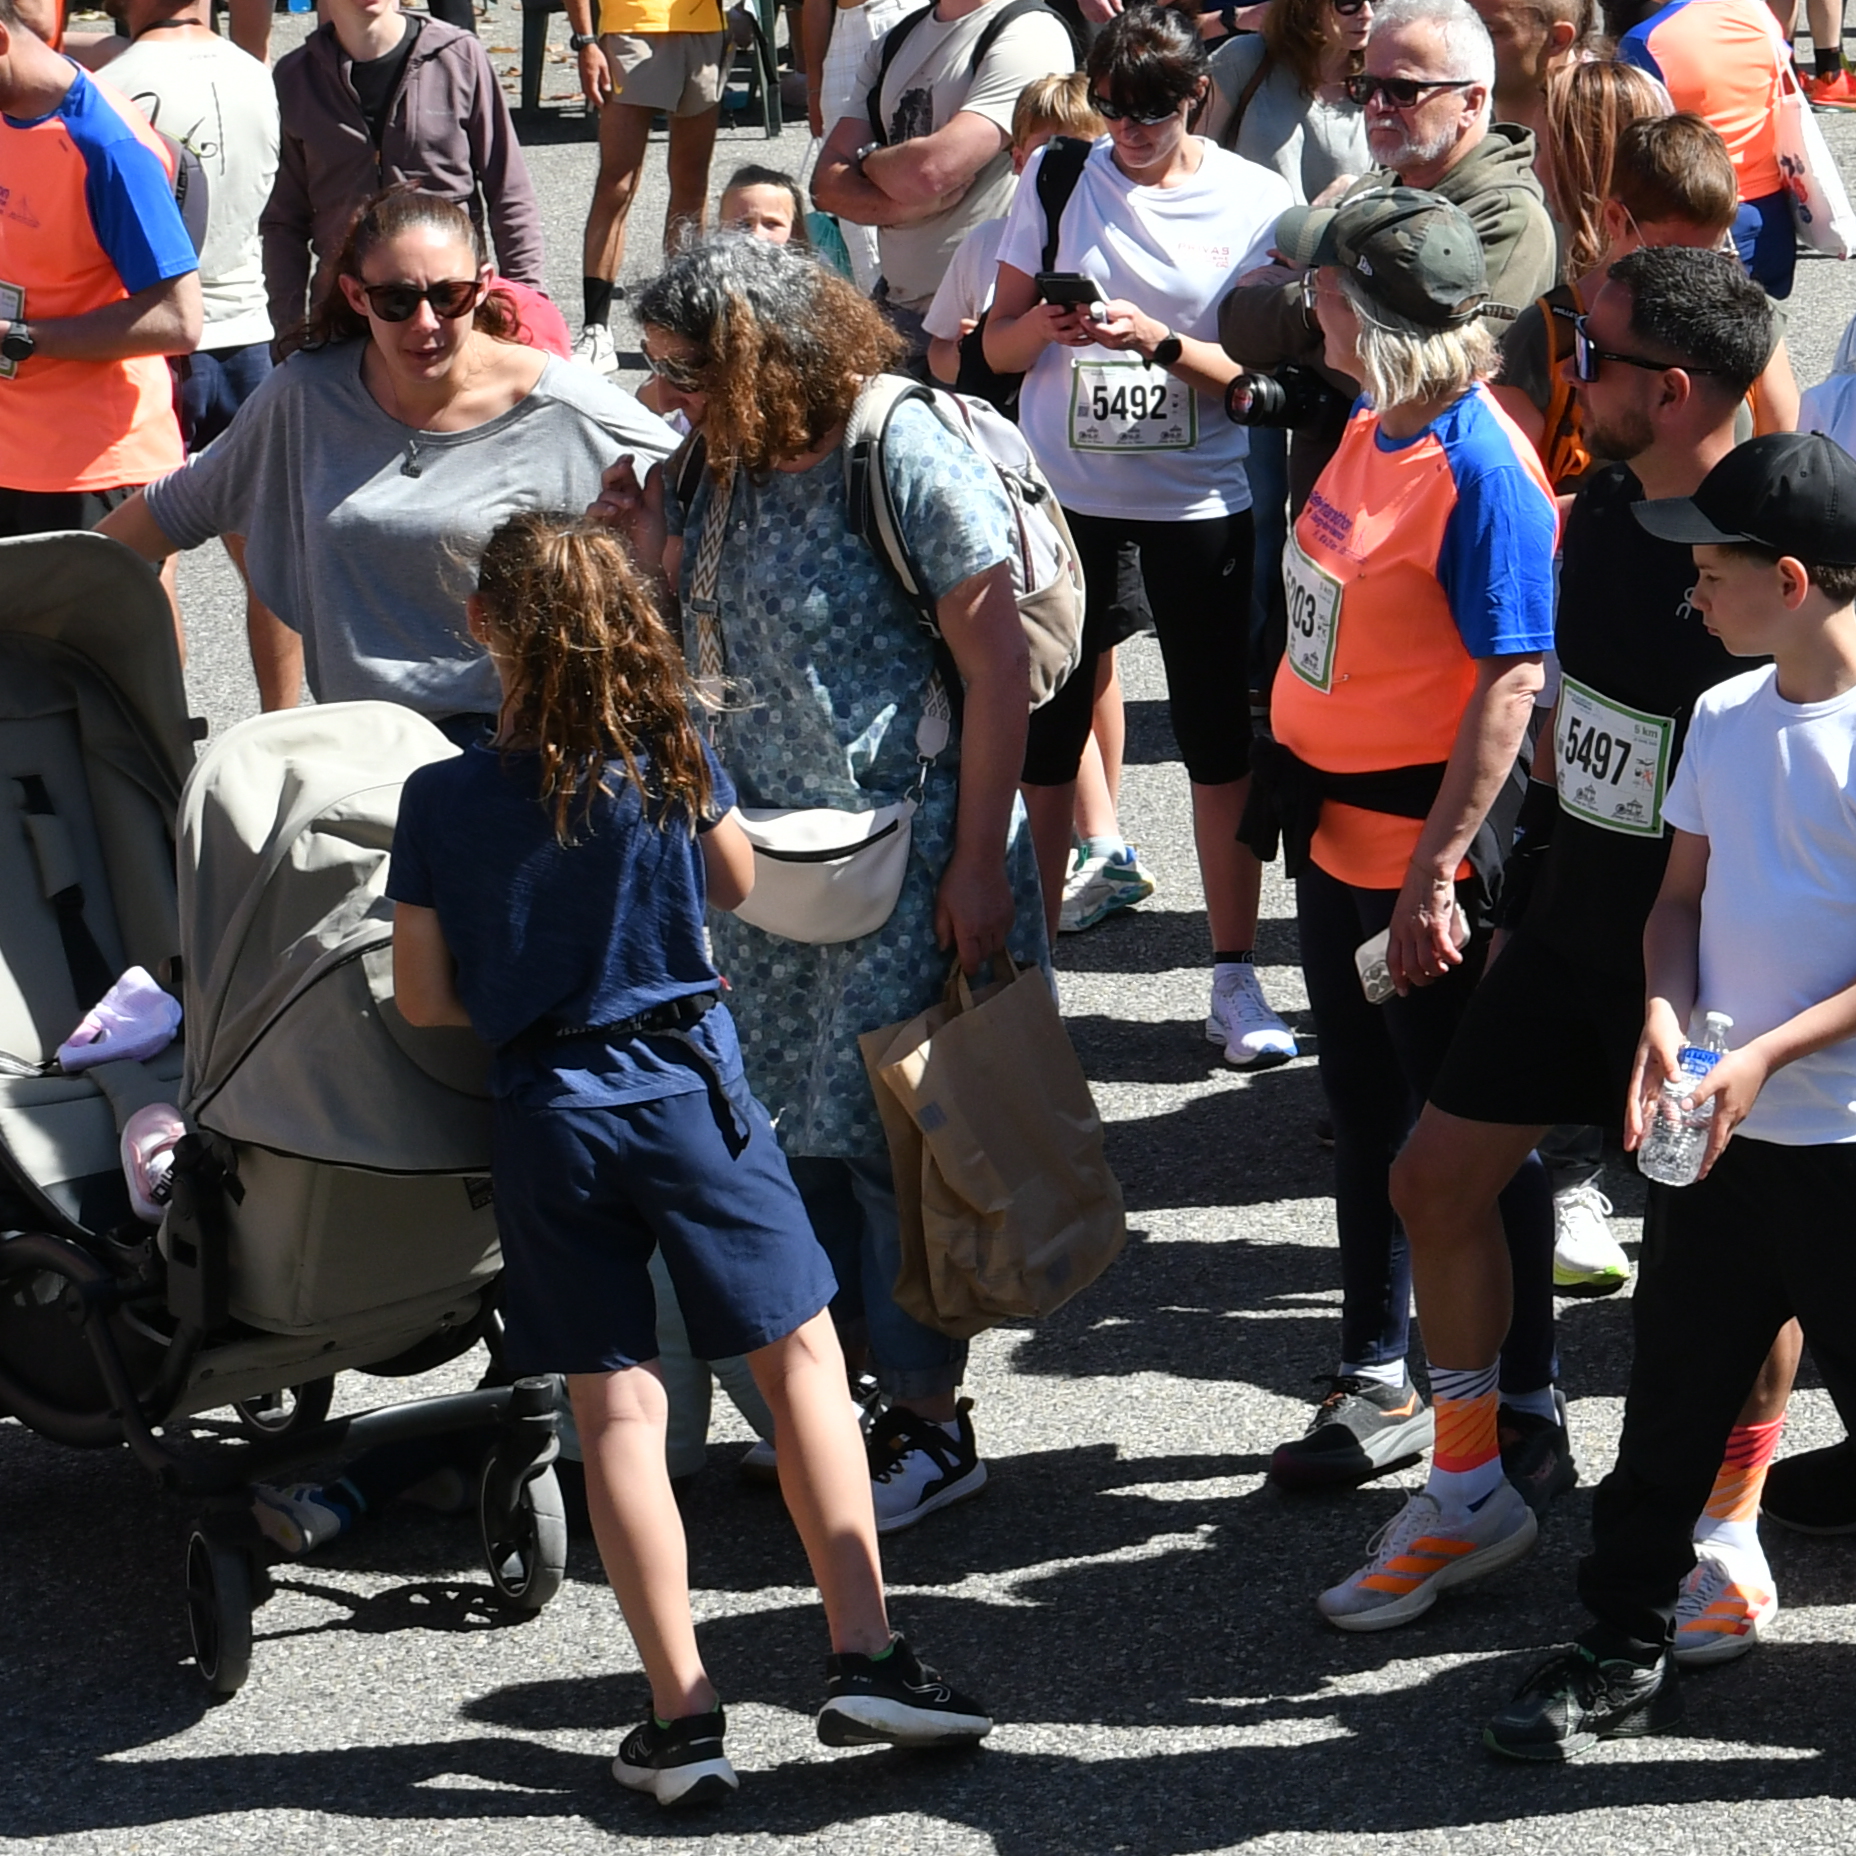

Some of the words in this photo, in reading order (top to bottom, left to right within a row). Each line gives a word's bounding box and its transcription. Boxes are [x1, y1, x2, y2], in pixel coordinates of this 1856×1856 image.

[1093, 385, 1168, 422] 5492
[1634, 724, 1642, 735] 5
[1643, 726, 1659, 739] km
[1565, 715, 1632, 787] 5497
